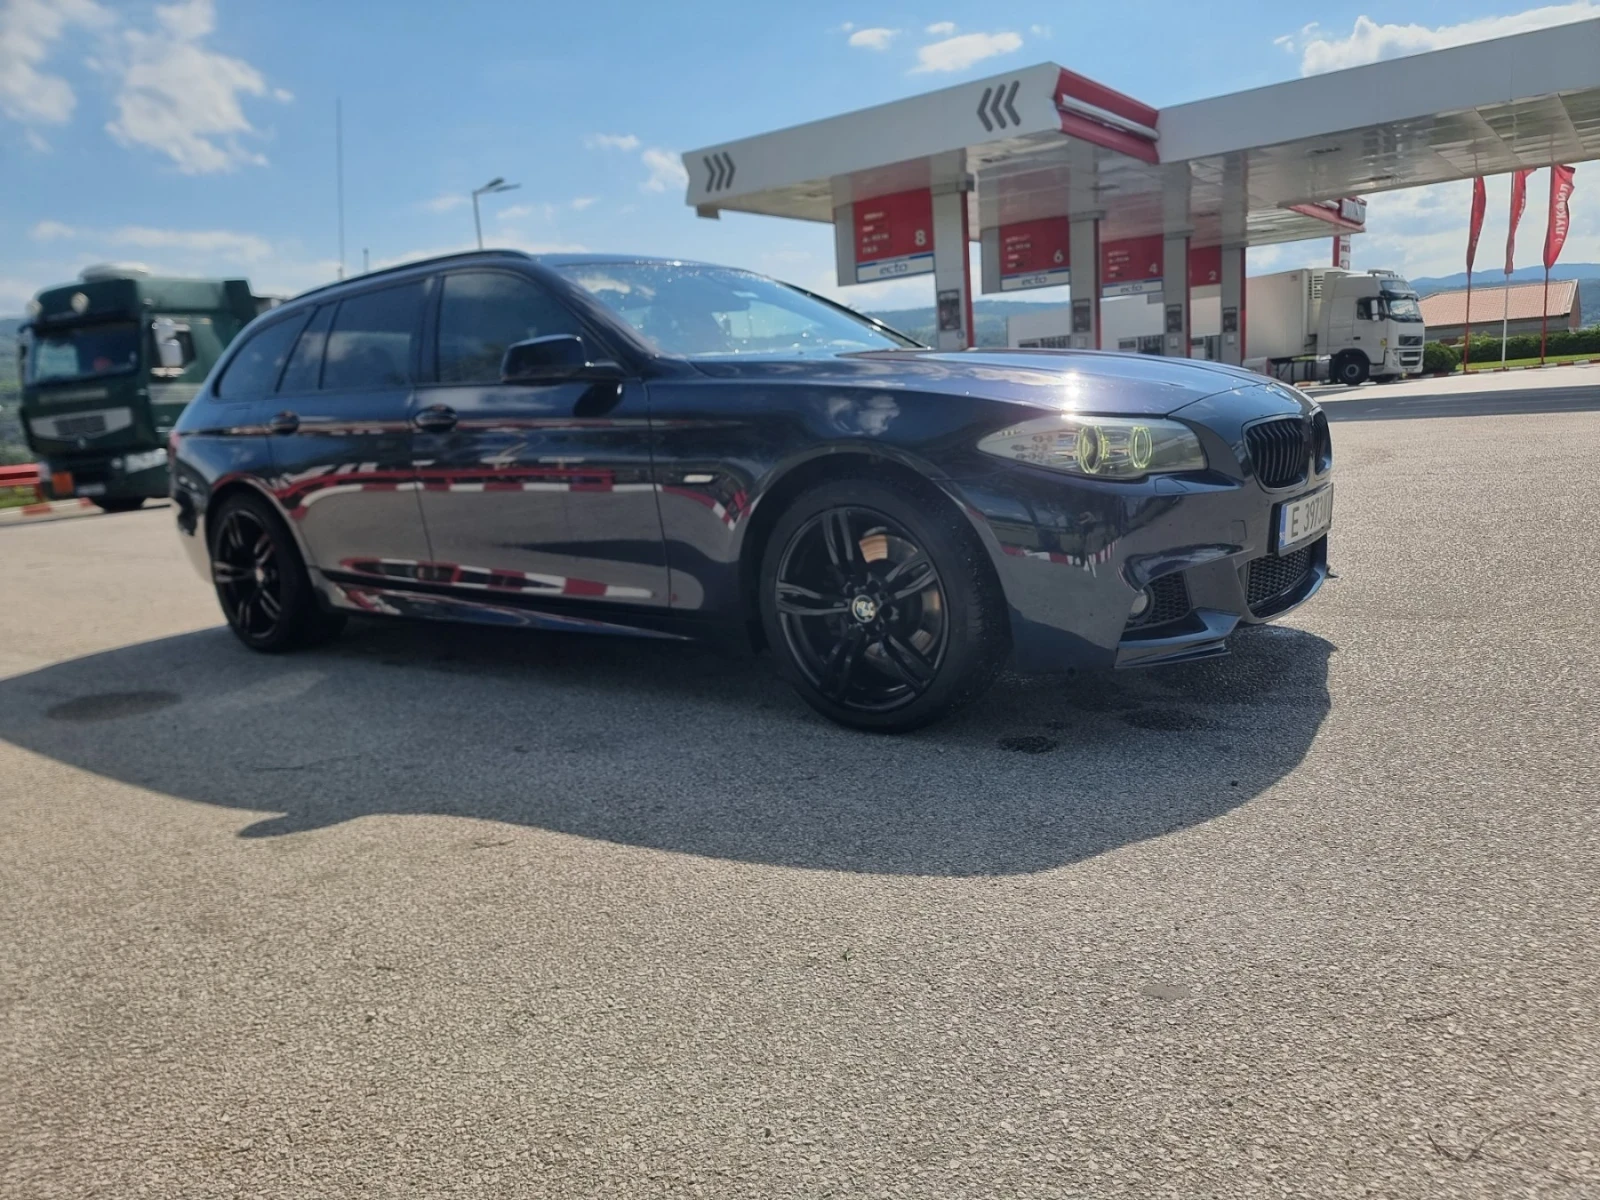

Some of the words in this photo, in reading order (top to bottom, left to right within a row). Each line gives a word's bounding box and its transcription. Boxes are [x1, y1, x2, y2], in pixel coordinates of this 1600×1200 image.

[915, 229, 927, 246] 8
[1053, 249, 1064, 264] 6
[879, 263, 908, 275] ecto
[1148, 262, 1158, 275] 4
[1022, 276, 1048, 286] ecto
[1208, 270, 1218, 281] 2
[1291, 506, 1300, 538] E
